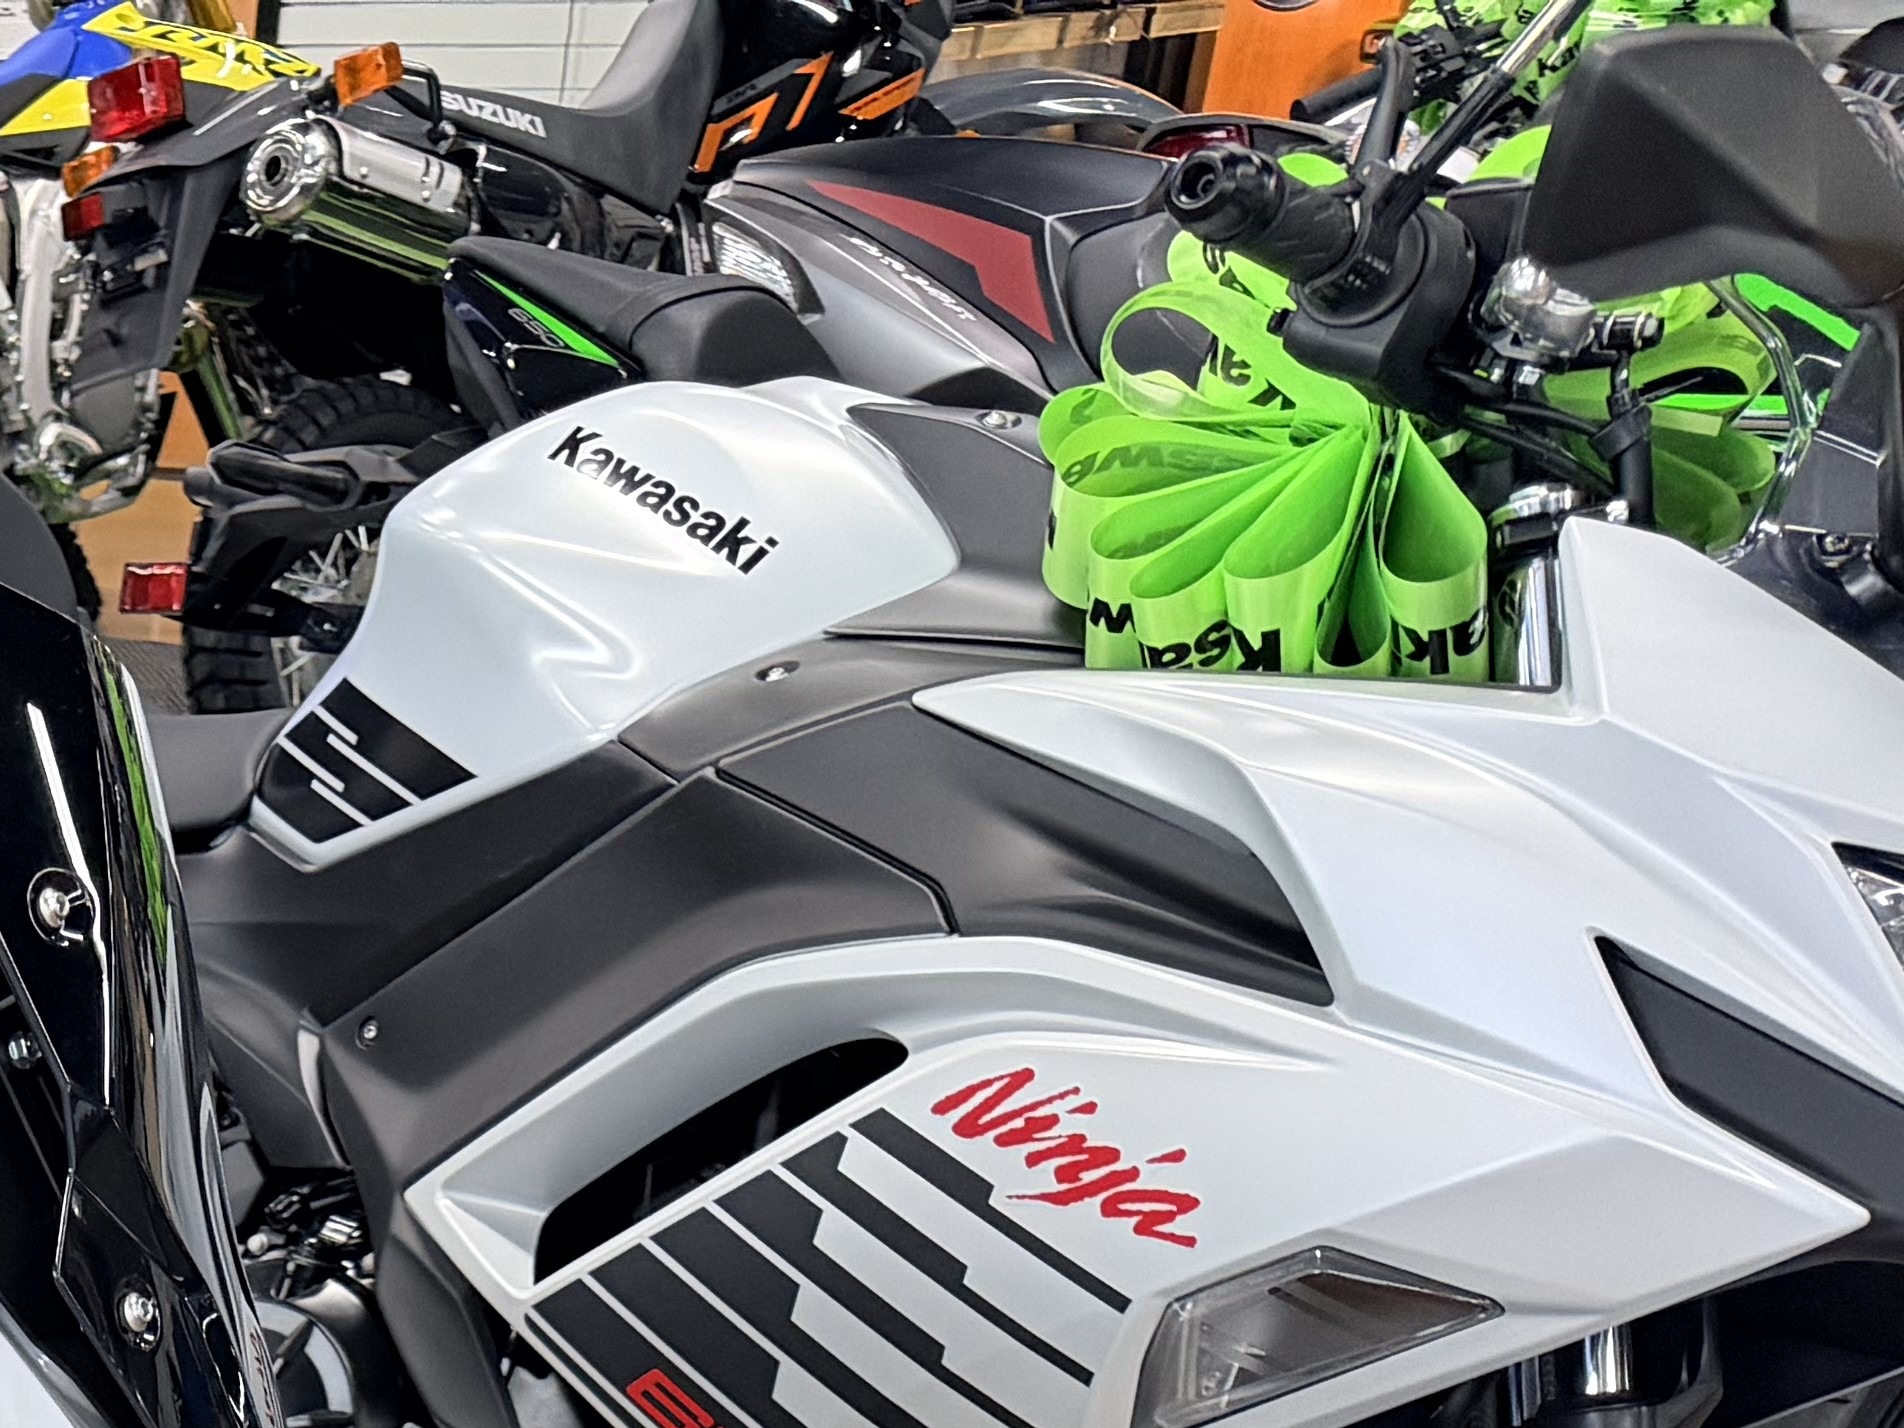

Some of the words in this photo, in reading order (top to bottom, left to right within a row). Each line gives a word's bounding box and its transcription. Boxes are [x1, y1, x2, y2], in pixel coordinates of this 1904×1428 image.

[440, 91, 548, 138] SUZUKI
[508, 308, 564, 347] 650
[547, 426, 780, 575] Kawasaki
[930, 1067, 1201, 1248] Ninja
